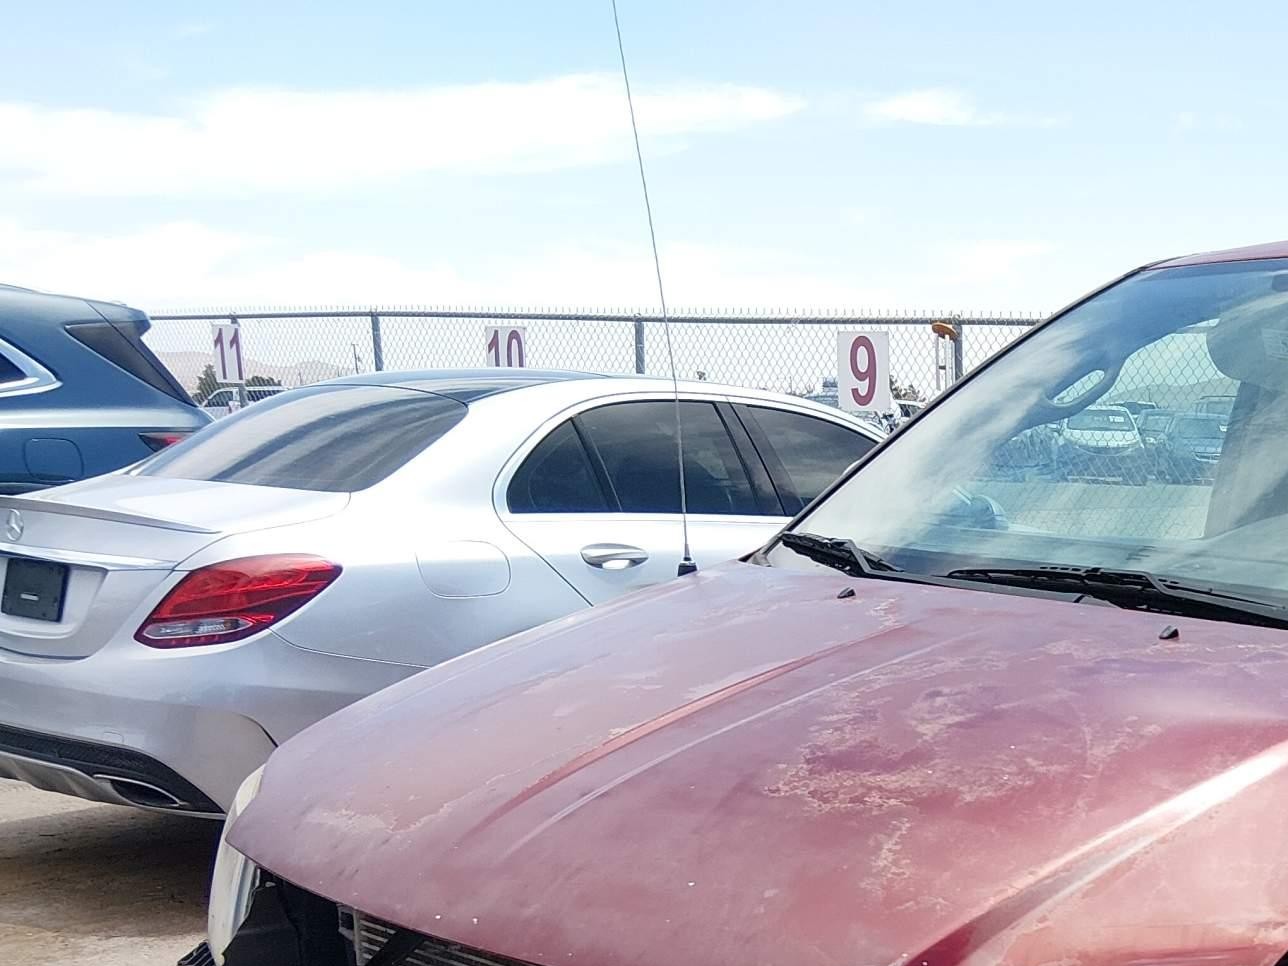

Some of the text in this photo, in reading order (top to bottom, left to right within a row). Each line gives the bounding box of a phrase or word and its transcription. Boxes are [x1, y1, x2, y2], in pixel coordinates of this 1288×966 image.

[213, 327, 244, 381] 11
[487, 329, 525, 368] 10
[849, 335, 877, 407] 9
